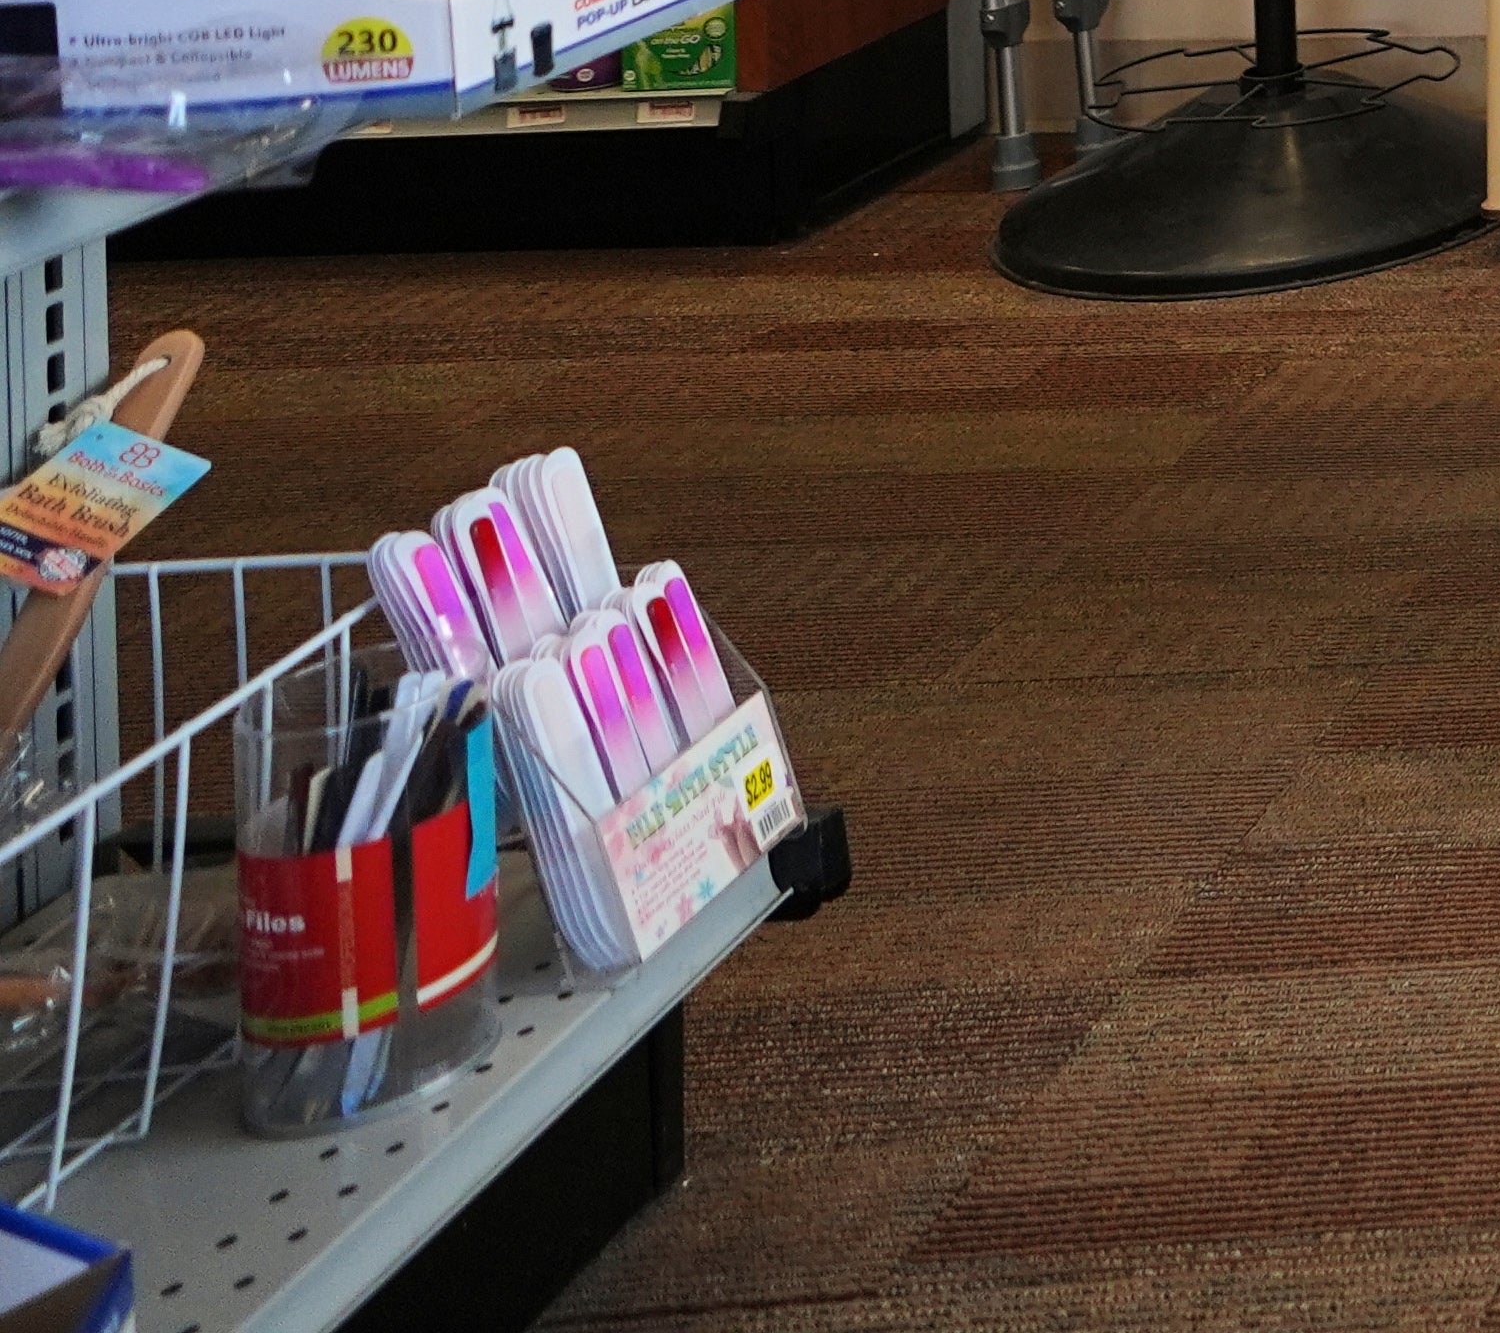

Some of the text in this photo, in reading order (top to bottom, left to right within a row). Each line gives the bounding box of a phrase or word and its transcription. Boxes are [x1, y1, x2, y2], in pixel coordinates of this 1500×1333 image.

[577, 0, 629, 31] POP-UP
[336, 29, 399, 57] 230
[323, 59, 413, 83] LUMENS
[68, 450, 168, 498] Bath Basics
[70, 503, 131, 538] Brush
[743, 761, 774, 807] $2.99
